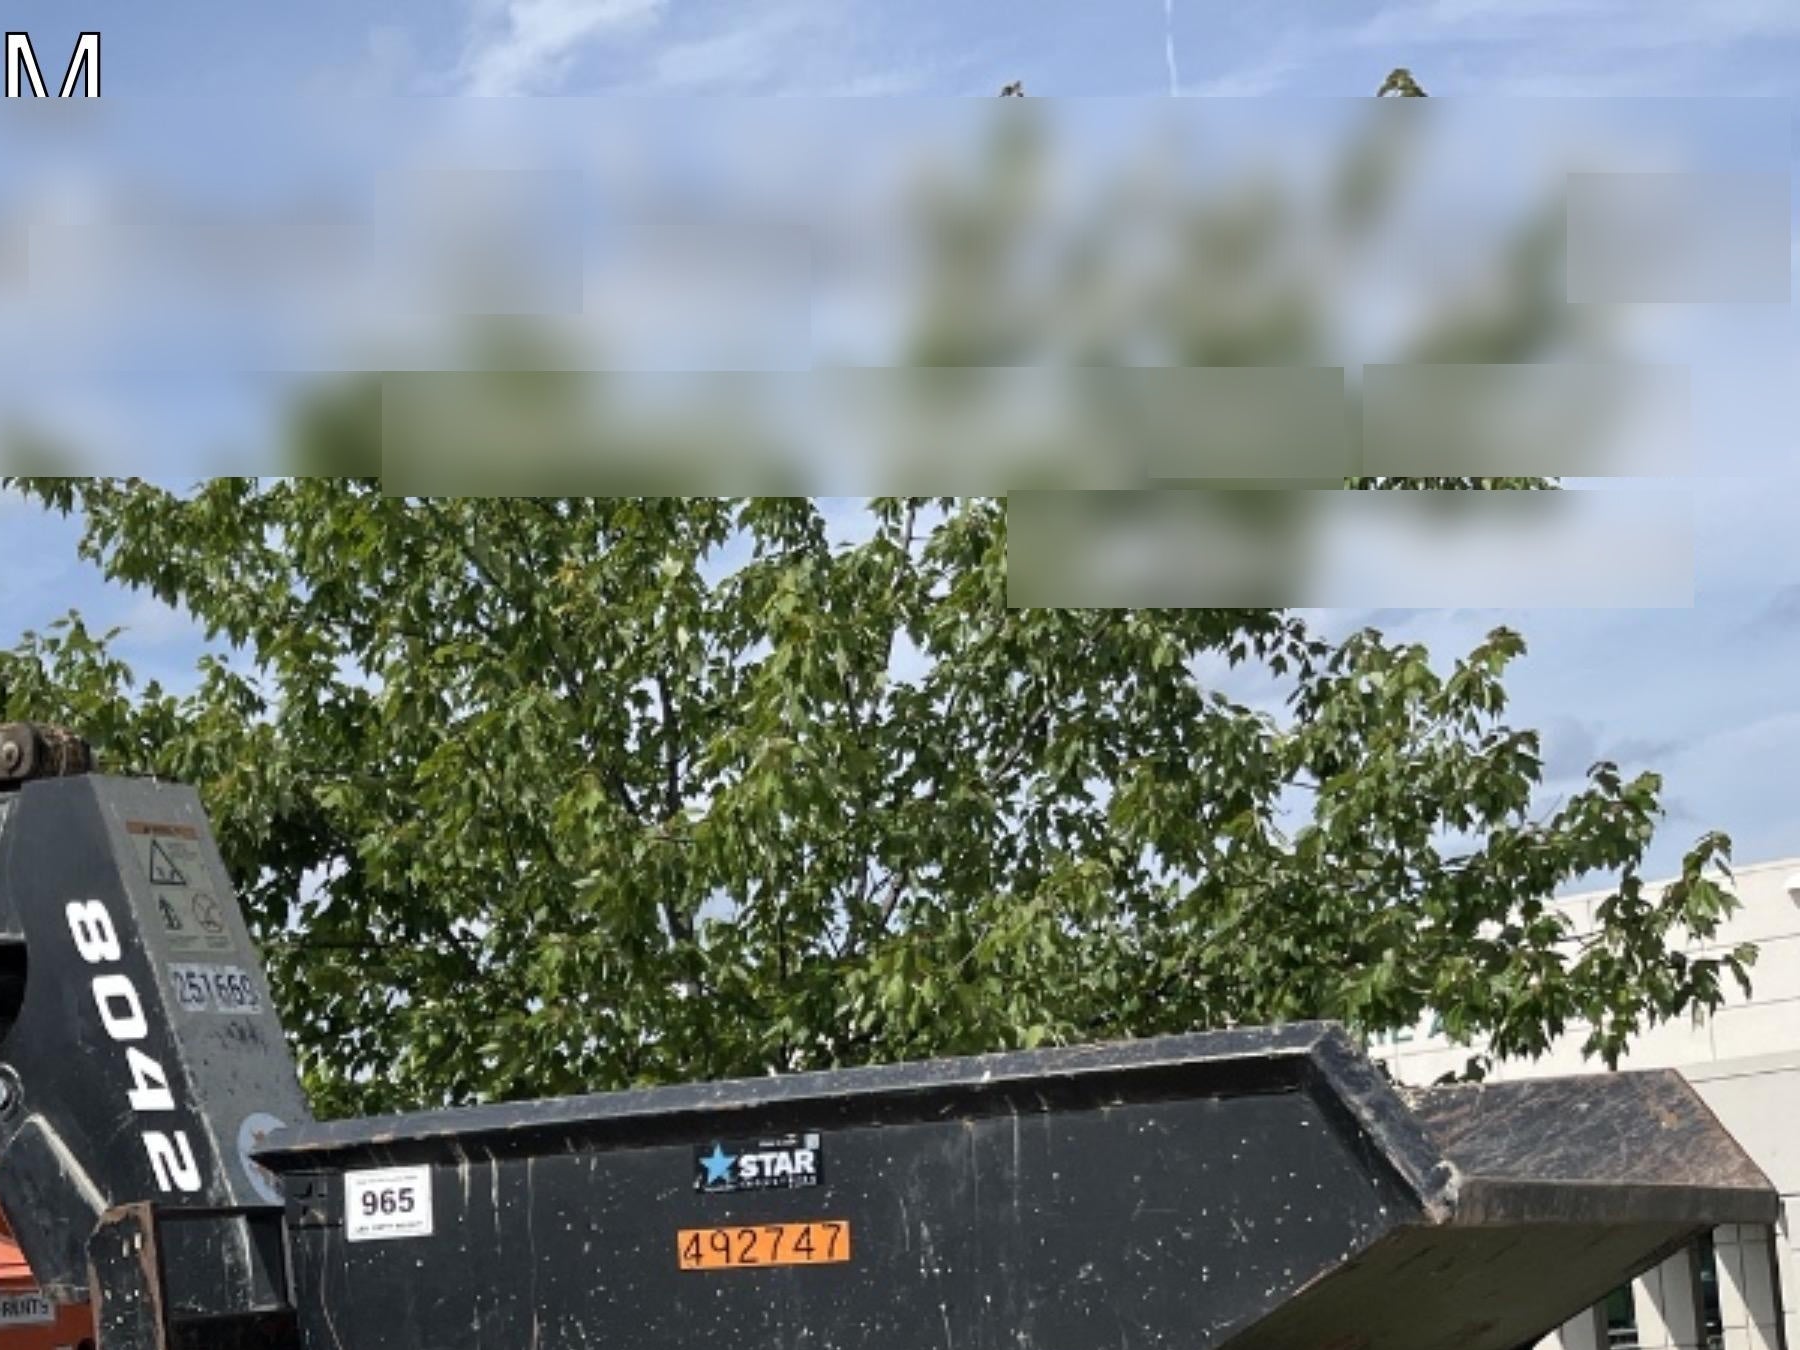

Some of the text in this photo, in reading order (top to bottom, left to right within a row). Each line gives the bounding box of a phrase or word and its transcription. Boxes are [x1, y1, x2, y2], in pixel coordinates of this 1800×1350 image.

[65, 899, 202, 1193] 8042
[738, 1149, 816, 1178] STAR
[361, 1187, 416, 1217] 965
[682, 1222, 842, 1267] 492747
